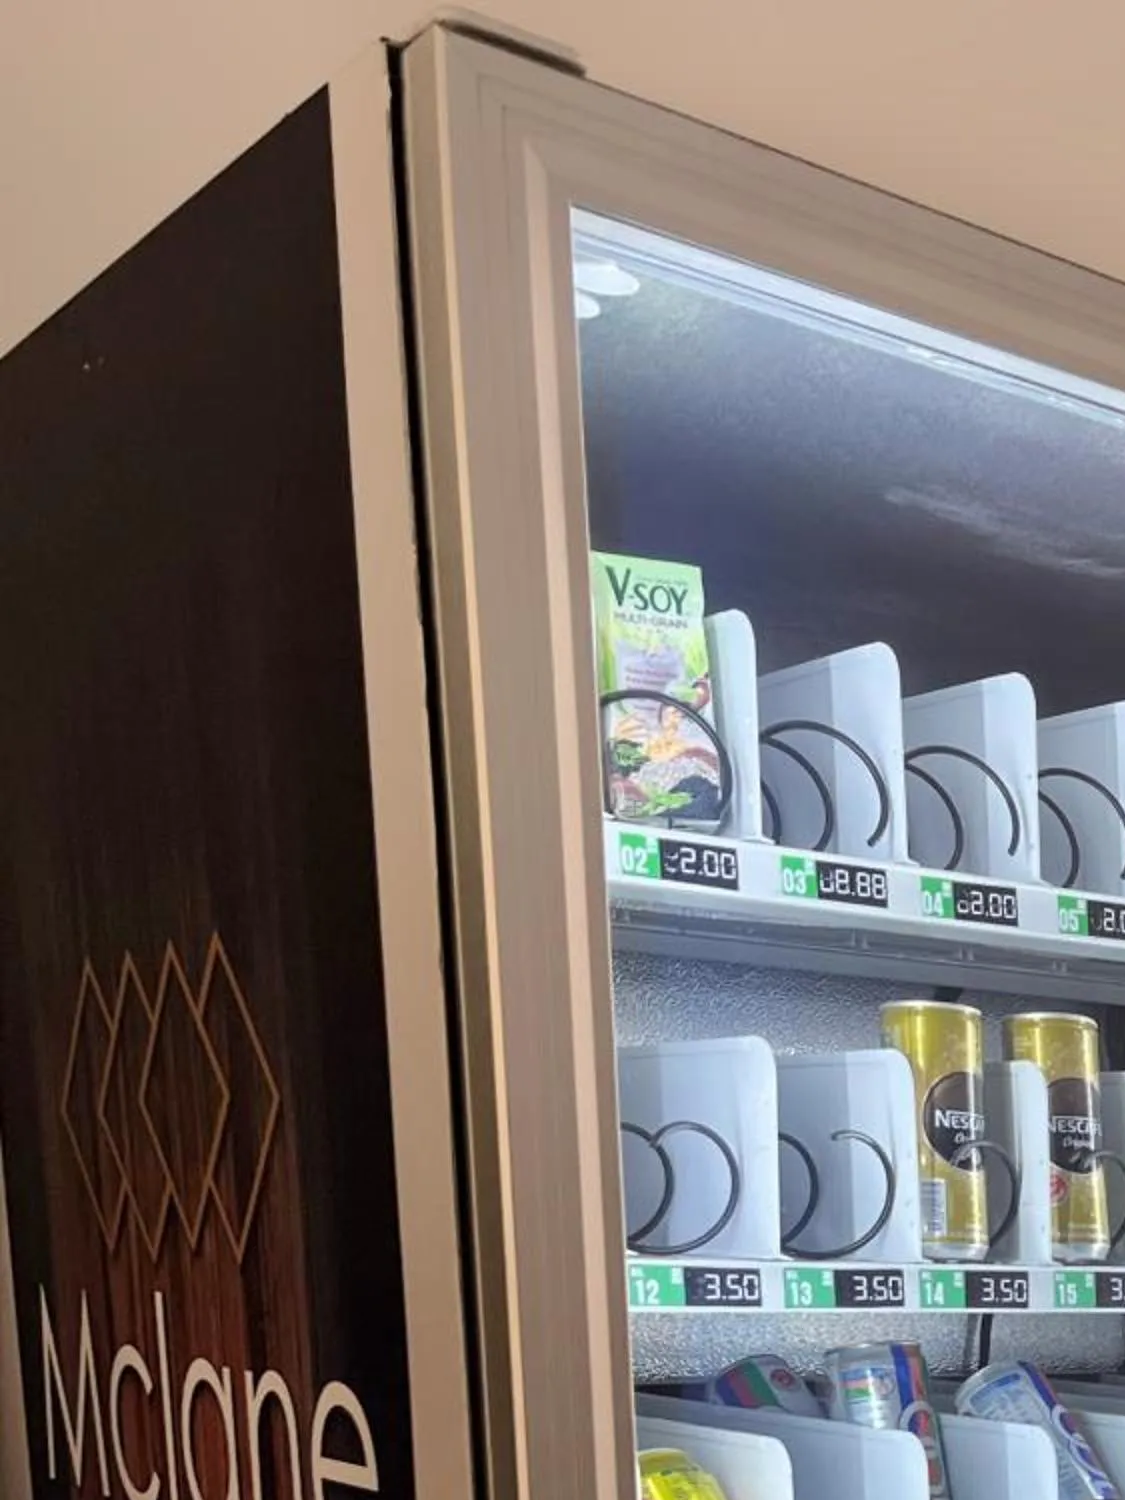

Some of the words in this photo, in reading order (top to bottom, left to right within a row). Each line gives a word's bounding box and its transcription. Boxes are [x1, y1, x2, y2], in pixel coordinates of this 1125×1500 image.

[605, 566, 689, 615] V-SOY
[620, 846, 649, 874] 02
[782, 868, 808, 895] 03
[922, 890, 945, 916] 04
[1059, 909, 1078, 932] 05
[634, 1279, 660, 1305] 12
[703, 1273, 760, 1300] 3.50
[791, 1281, 813, 1307] 13
[853, 1275, 904, 1301] 3.50
[925, 1282, 945, 1305] 14
[981, 1277, 1028, 1303] 3.50
[1058, 1284, 1077, 1305] 15
